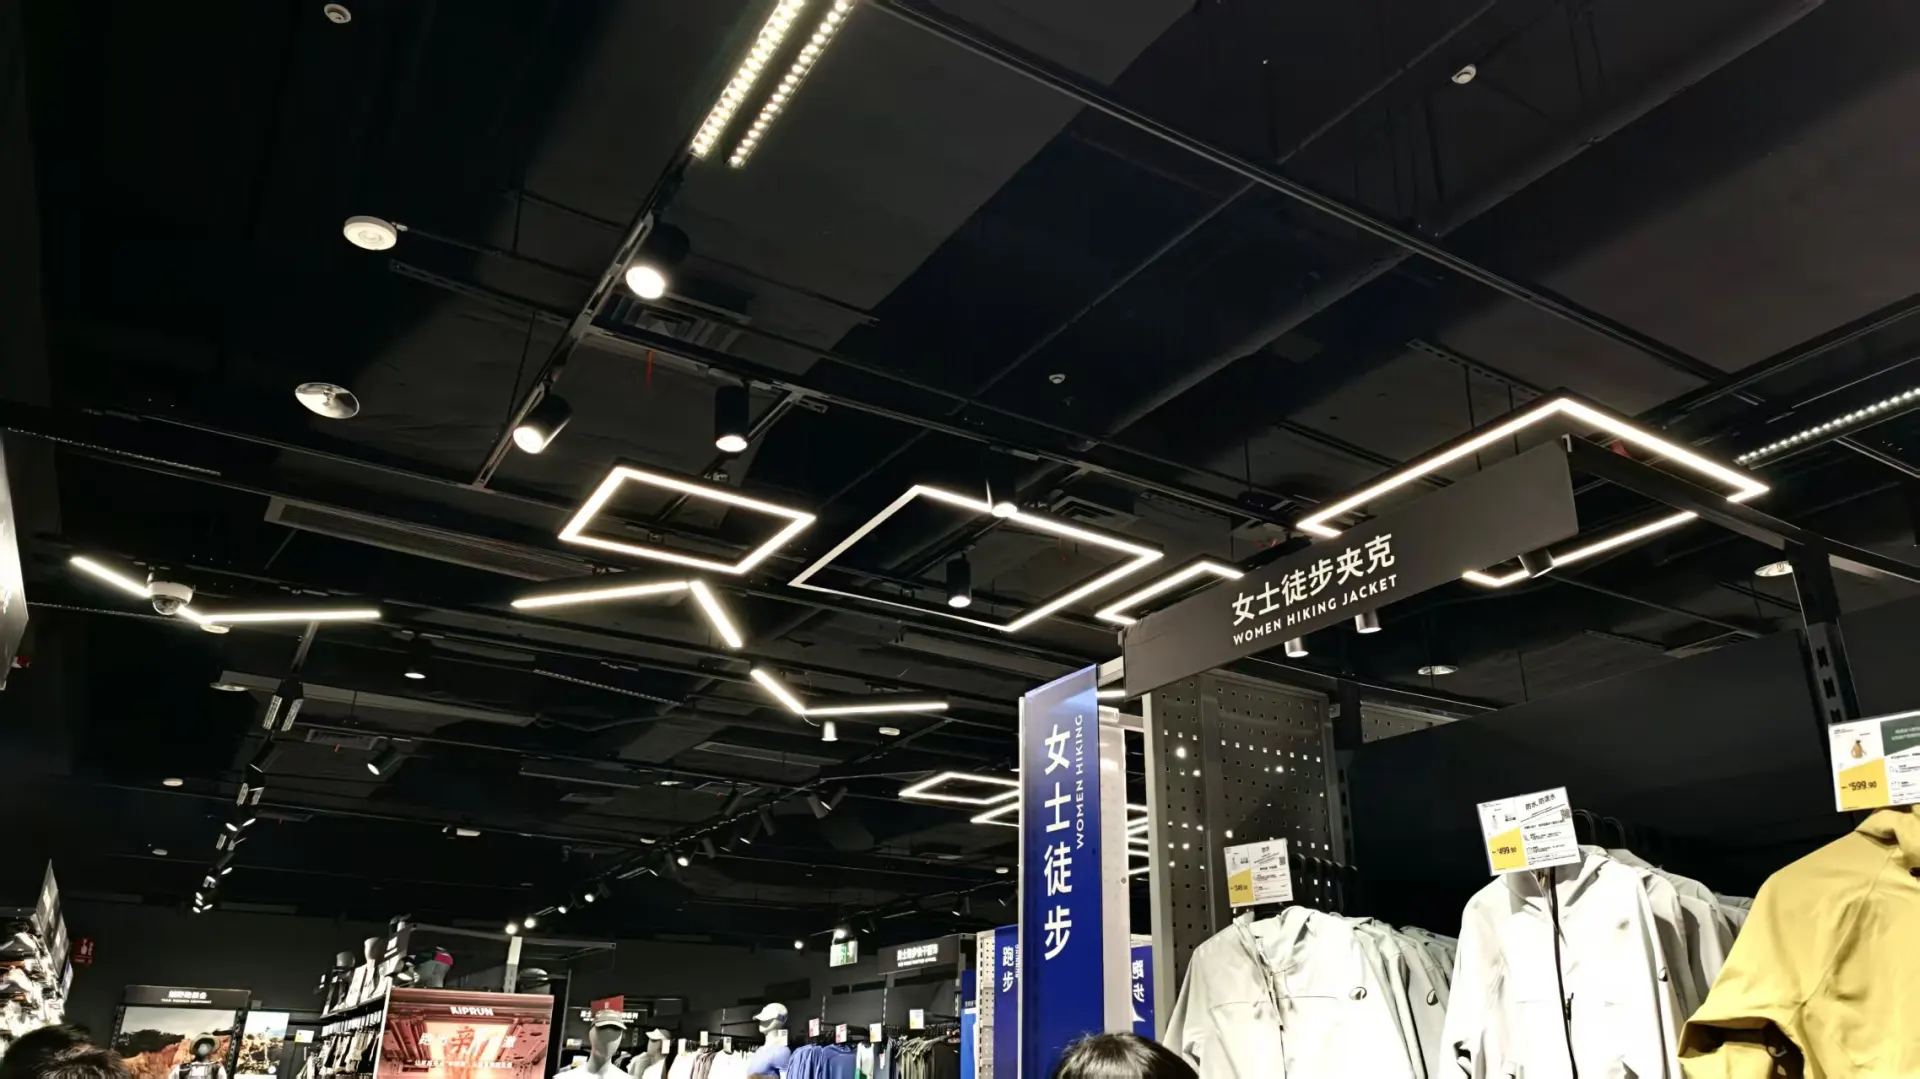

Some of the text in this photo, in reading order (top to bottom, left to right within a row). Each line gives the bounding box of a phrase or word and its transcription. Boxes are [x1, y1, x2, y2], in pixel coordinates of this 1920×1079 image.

[1232, 533, 1395, 626] 女士徒步夹克
[1233, 574, 1397, 646] WOMEN HIKING JACKET
[1075, 713, 1085, 850] WOMEN HIKING
[1044, 724, 1072, 961] 女士徒步
[1002, 946, 1014, 992] 跑步
[450, 1006, 494, 1016] KIPRUN
